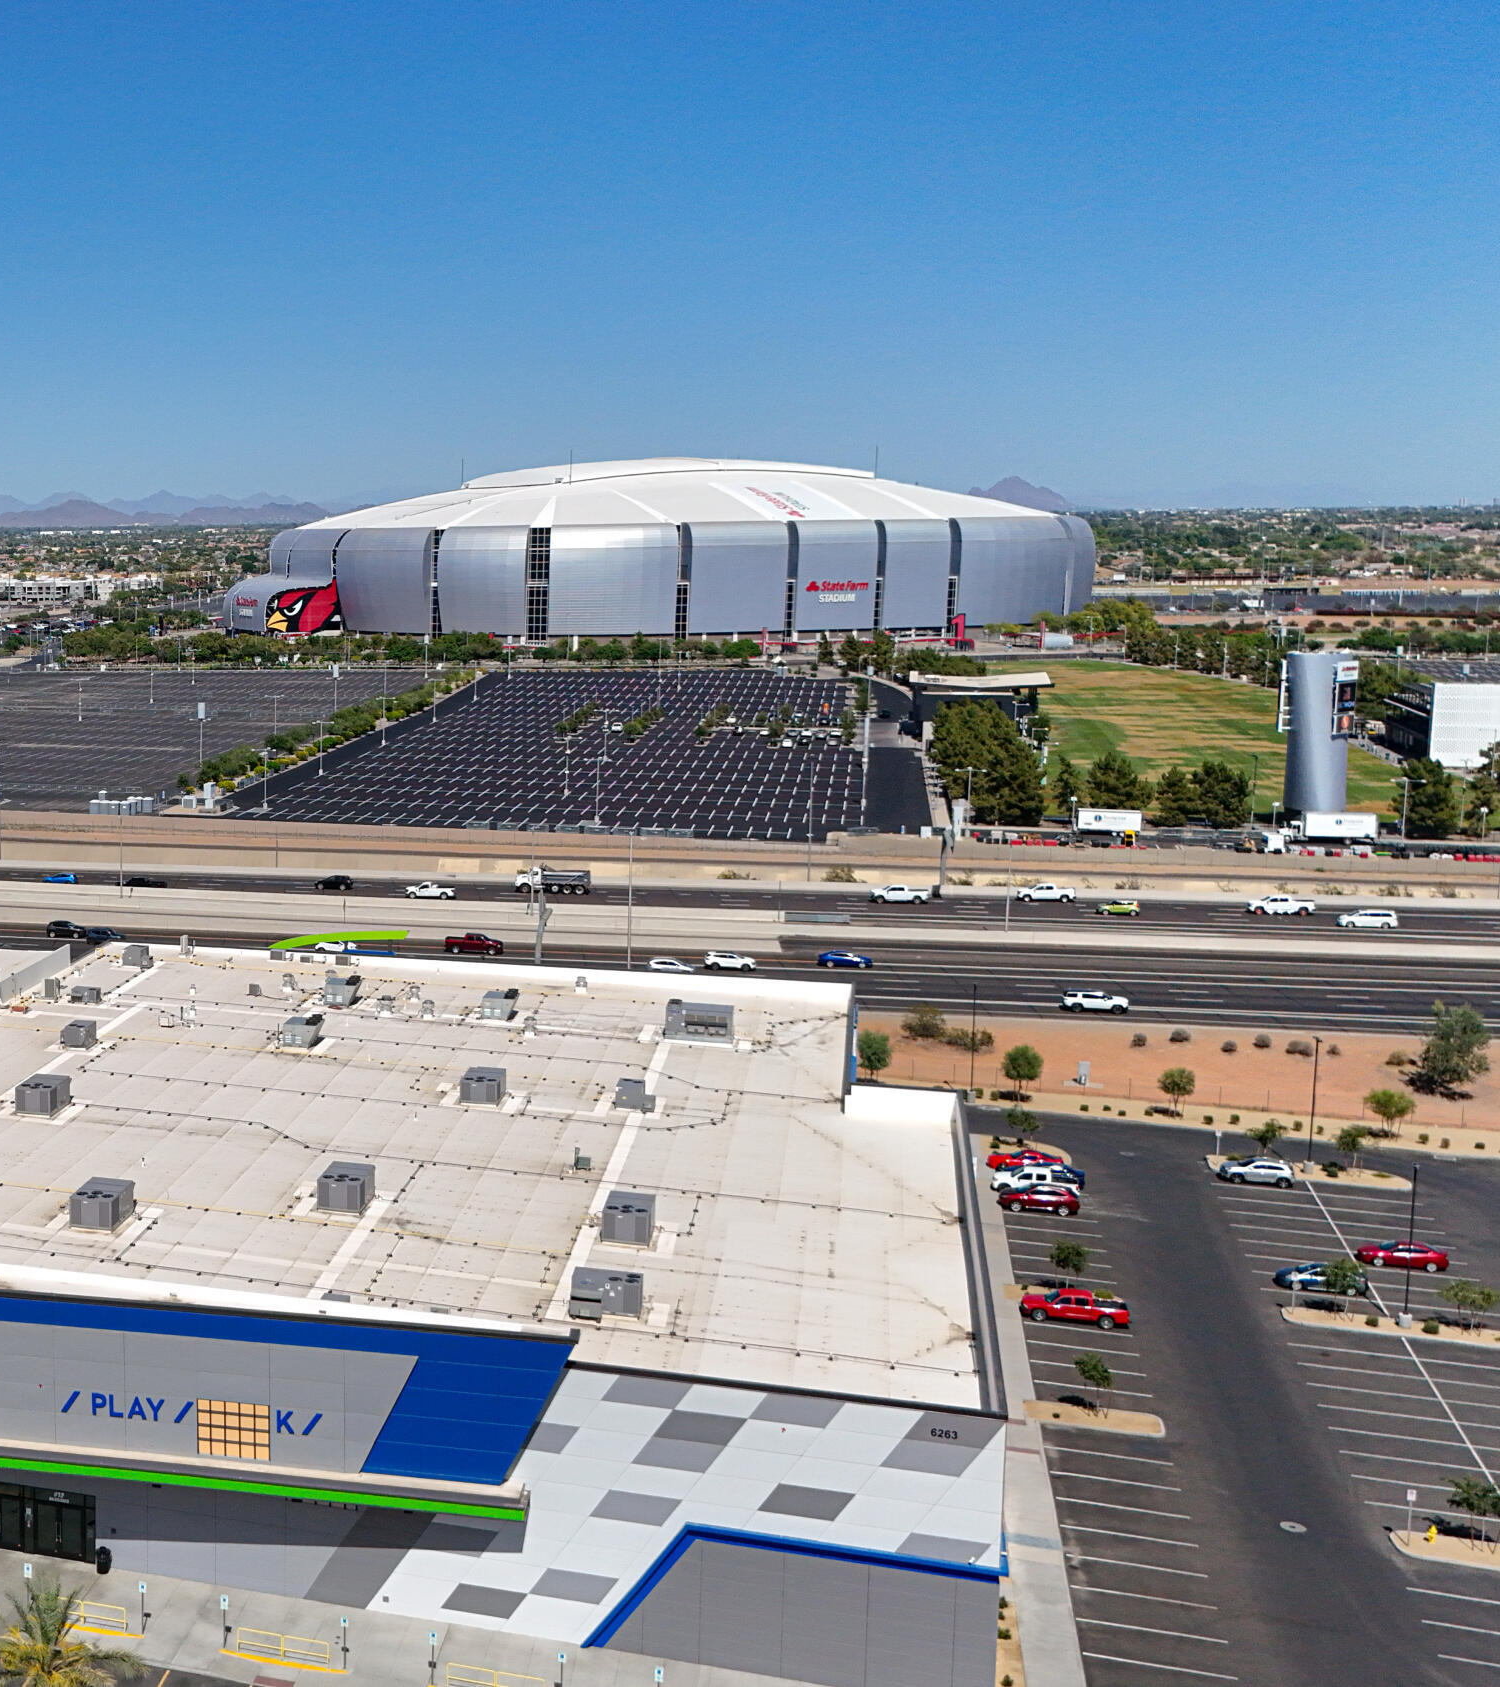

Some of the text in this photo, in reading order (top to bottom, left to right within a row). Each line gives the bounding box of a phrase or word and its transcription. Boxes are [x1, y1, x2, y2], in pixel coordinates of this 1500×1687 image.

[820, 580, 869, 592] State Farm
[818, 593, 856, 603] STADIUM
[930, 1428, 958, 1440] 6263
